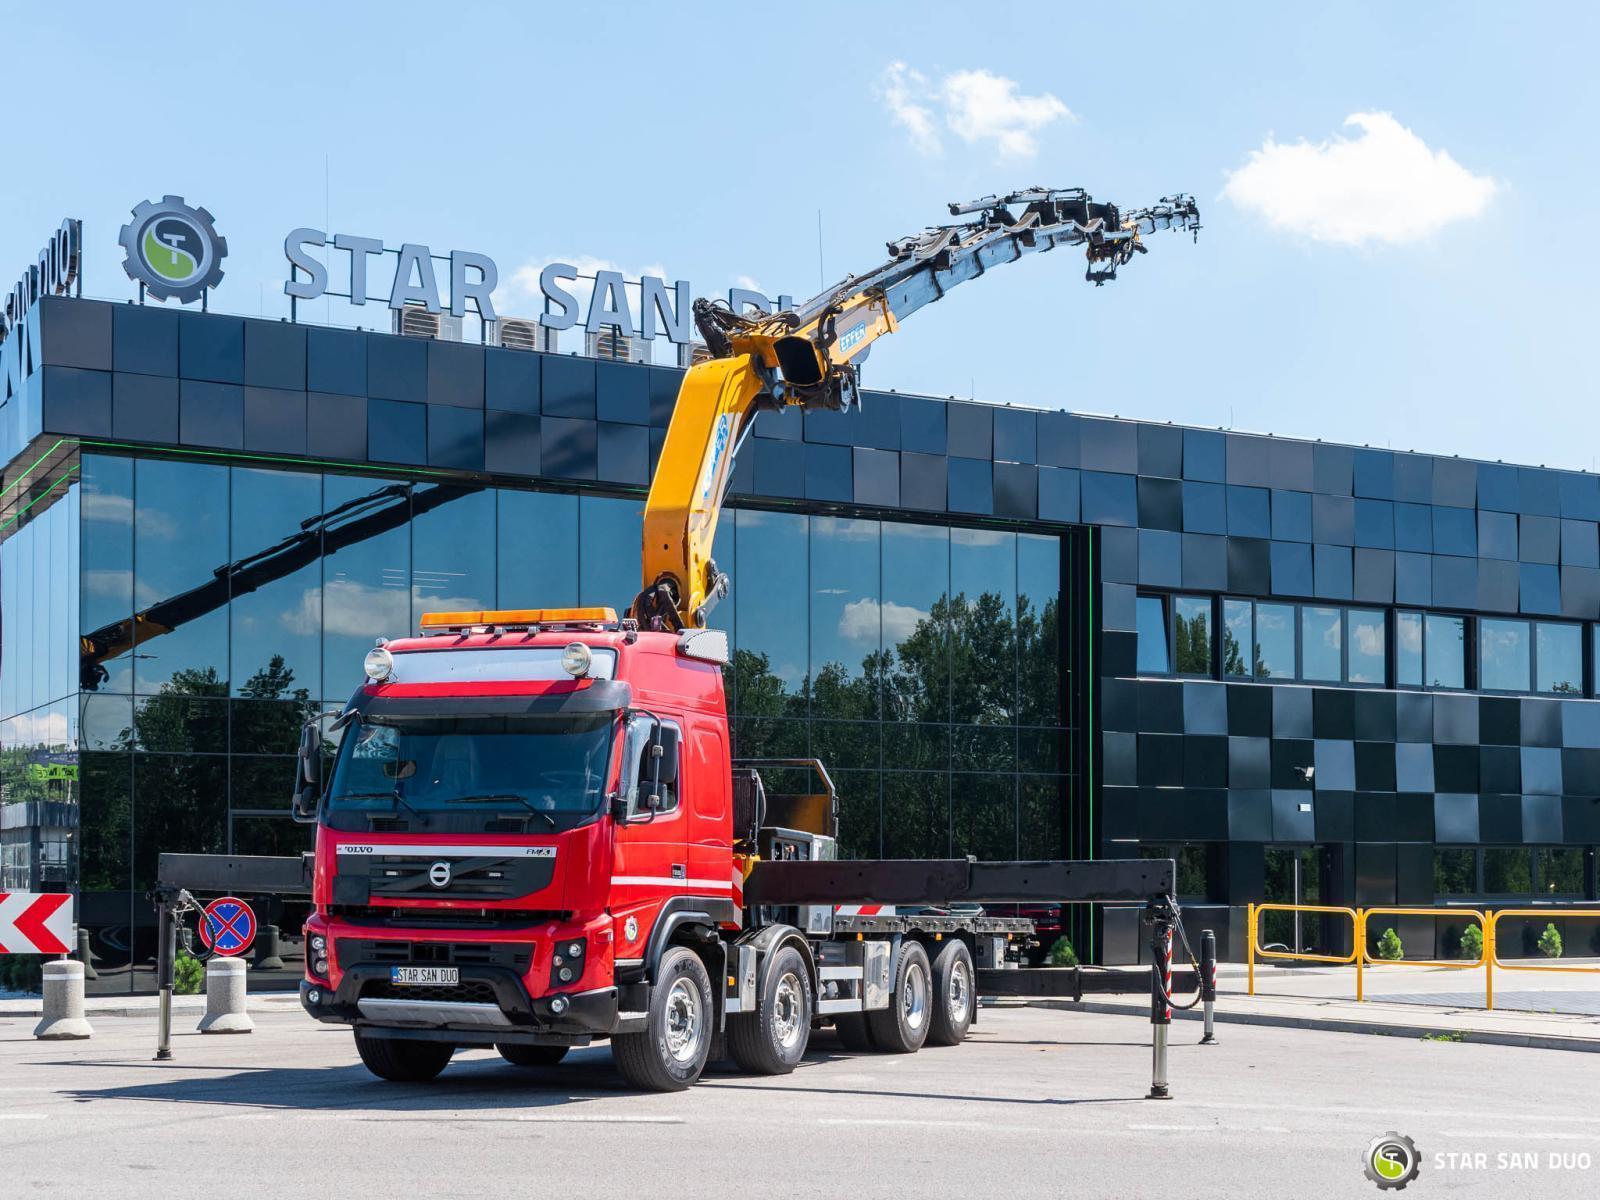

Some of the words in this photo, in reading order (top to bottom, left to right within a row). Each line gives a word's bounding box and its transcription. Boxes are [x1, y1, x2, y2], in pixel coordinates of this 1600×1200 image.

[284, 228, 498, 321] STAR
[540, 263, 690, 344] SAN
[343, 846, 373, 854] OLVO
[398, 968, 418, 982] STAR
[421, 969, 437, 982] SAN
[441, 969, 458, 982] DUO
